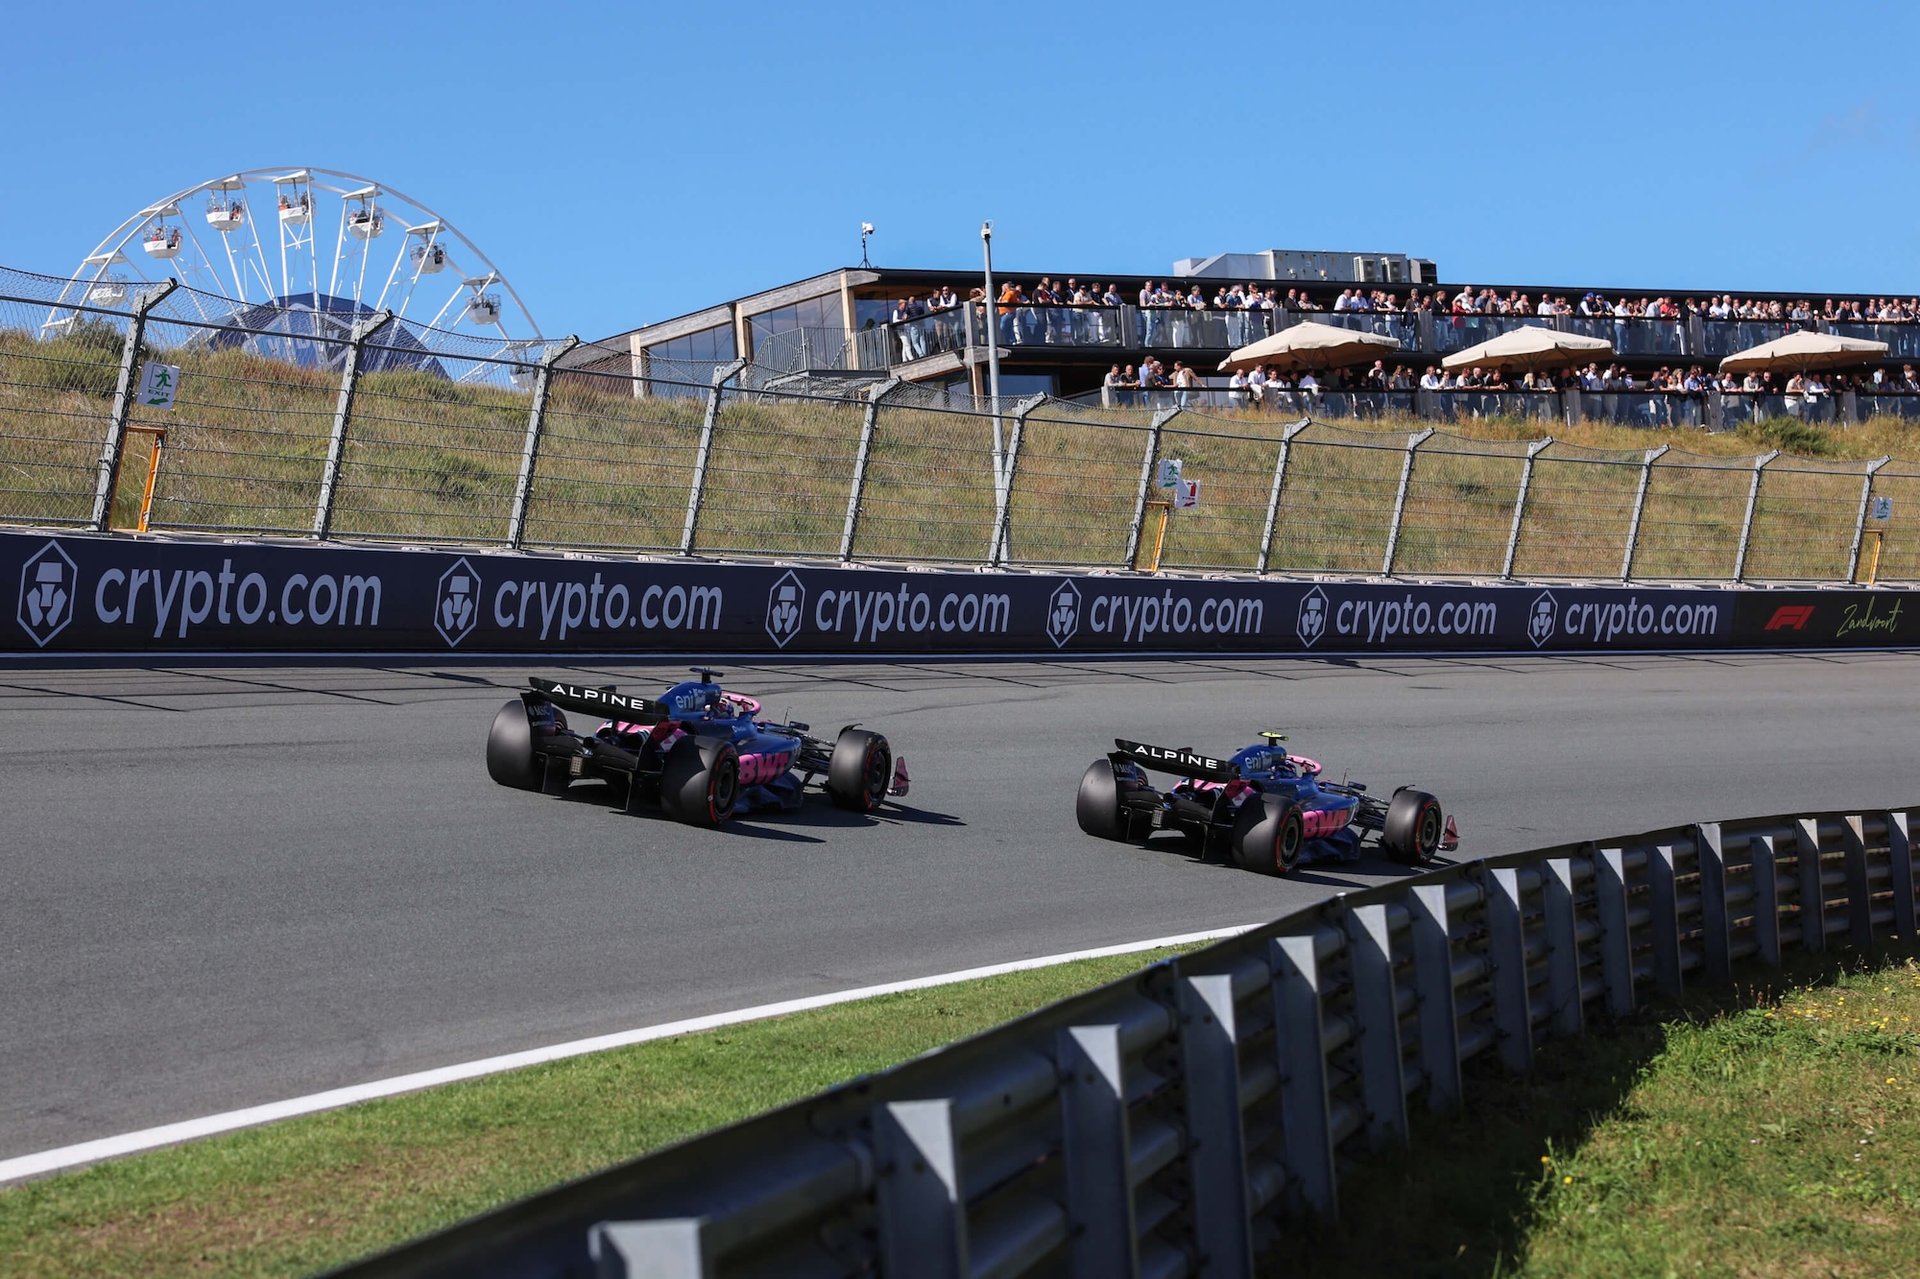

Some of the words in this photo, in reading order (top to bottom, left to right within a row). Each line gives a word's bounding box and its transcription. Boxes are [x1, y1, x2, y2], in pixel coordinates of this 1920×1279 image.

[148, 389, 170, 397] EXIT
[96, 559, 382, 638] crypto.com
[495, 573, 723, 641] crypto.com
[816, 583, 1010, 643] crypto.com
[1091, 589, 1264, 643] crypto.com
[1337, 594, 1497, 643] crypto.com
[1565, 597, 1718, 642] crypto.com
[1836, 595, 1904, 637] Zandvoort
[551, 684, 644, 710] ALPINE
[738, 752, 791, 785] BWT
[1135, 745, 1218, 769] ALPINE
[1302, 808, 1349, 839] BWT
